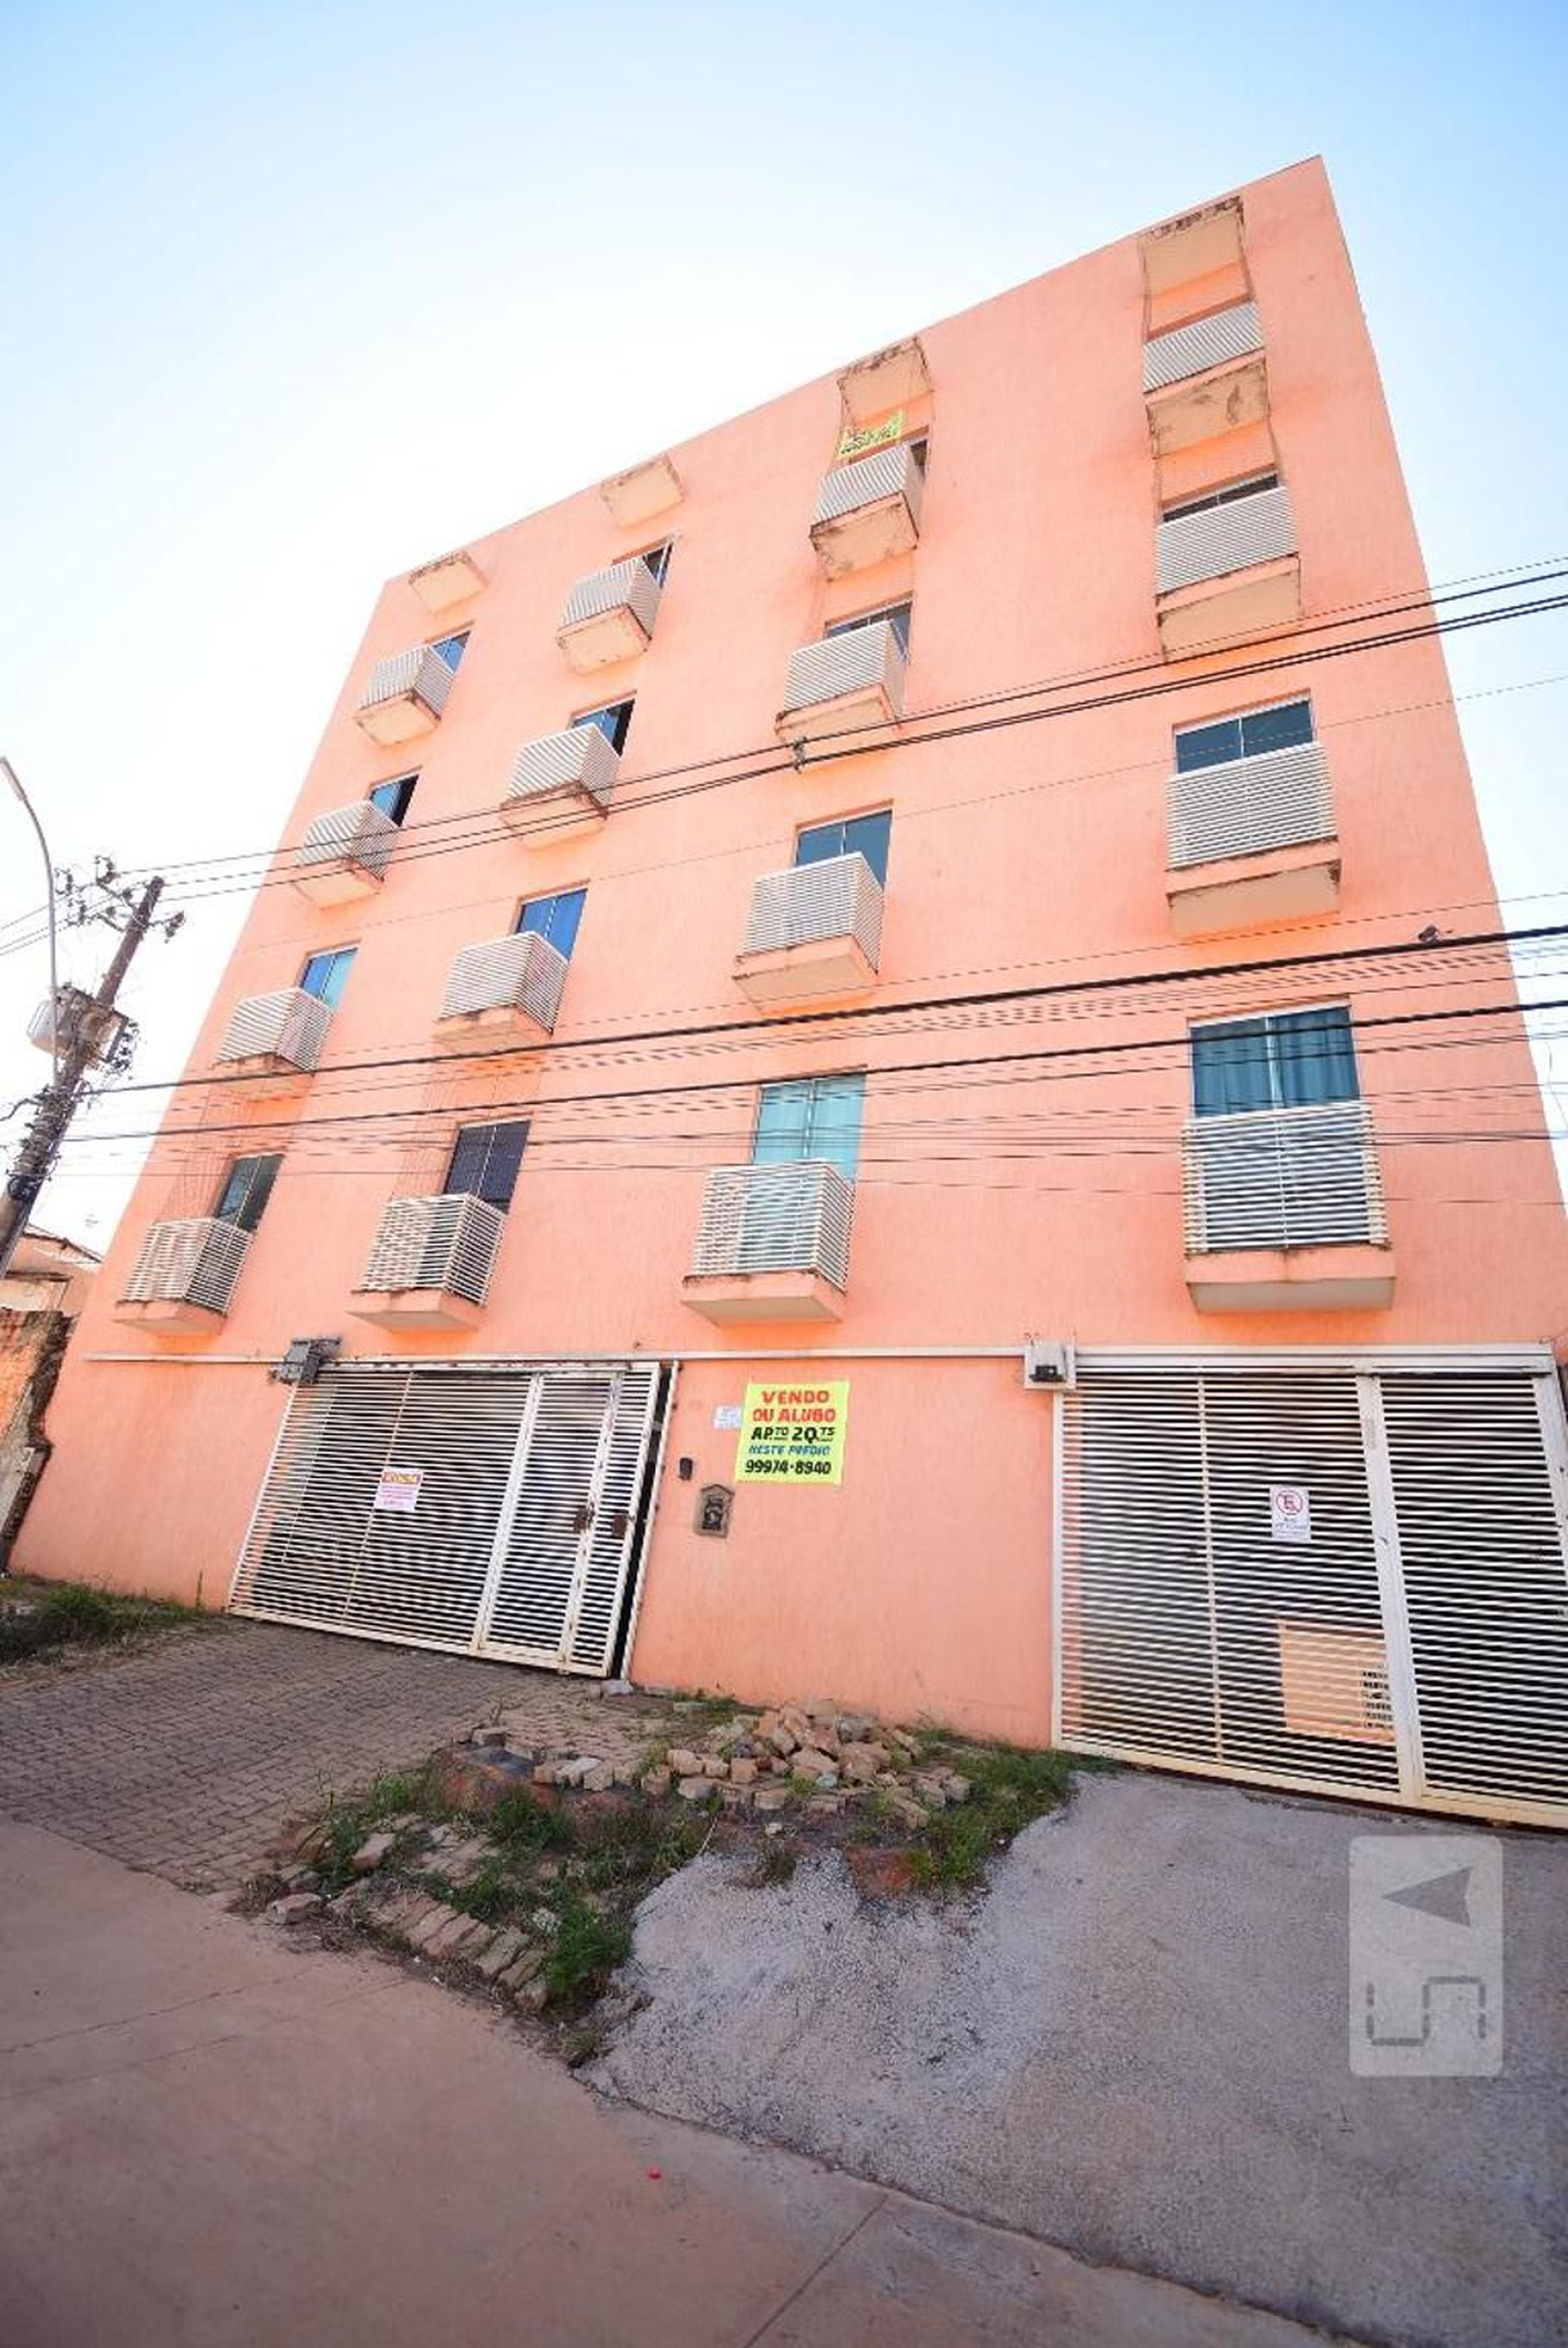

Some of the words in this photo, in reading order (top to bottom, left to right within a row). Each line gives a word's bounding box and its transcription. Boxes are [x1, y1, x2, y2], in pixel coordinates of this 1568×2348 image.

[762, 1390, 829, 1404] VENDO
[753, 1409, 774, 1422] OU
[778, 1408, 836, 1422] ALUGO
[748, 1445, 785, 1455] NESTE
